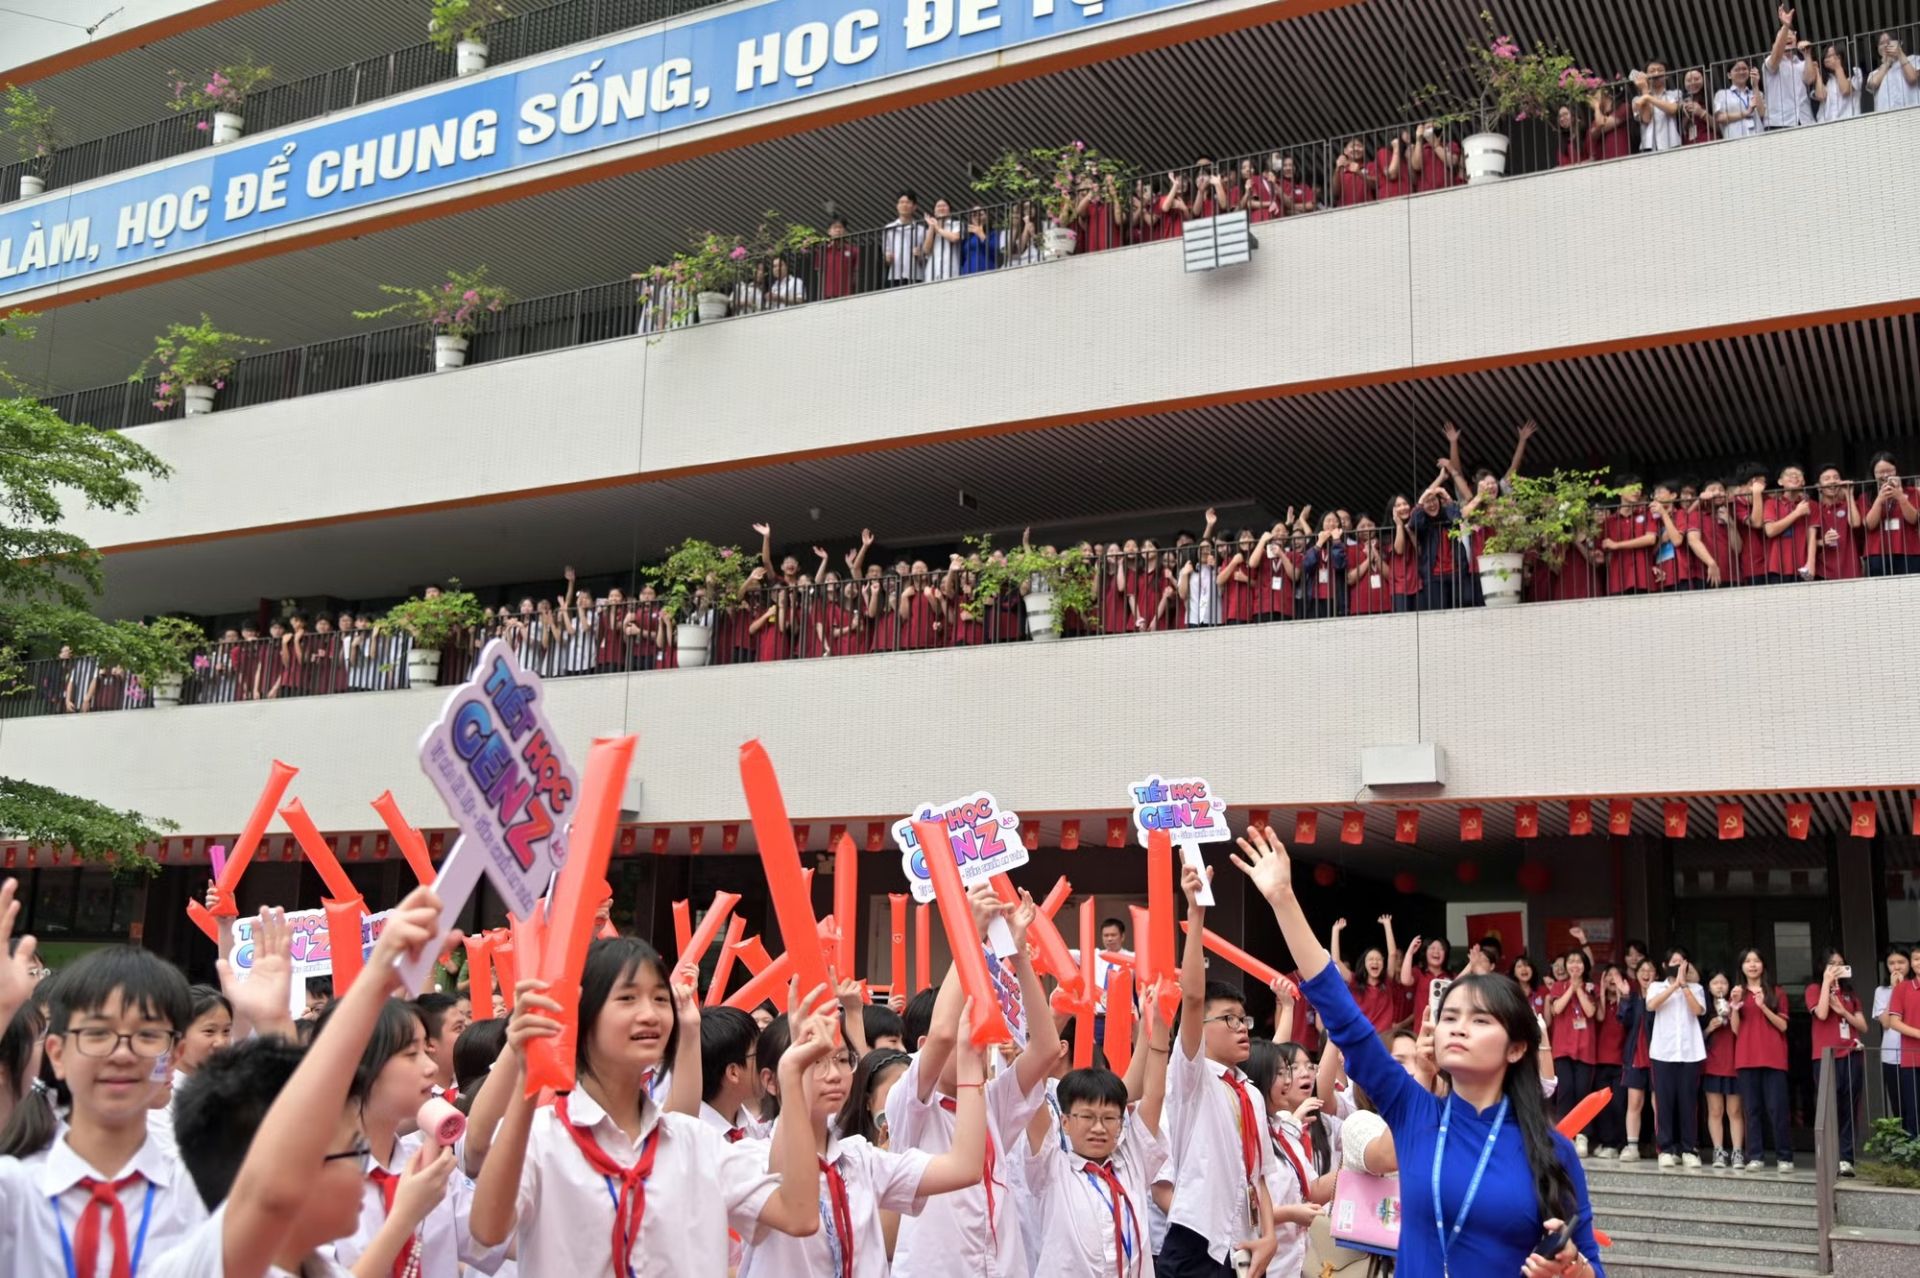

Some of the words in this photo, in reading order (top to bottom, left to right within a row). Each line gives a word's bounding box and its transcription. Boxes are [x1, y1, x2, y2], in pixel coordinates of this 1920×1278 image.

[0, 220, 99, 279] LÀM,
[116, 185, 210, 250] HỌC
[224, 141, 297, 221] ĐỂ
[306, 109, 498, 198] CHUNG
[517, 58, 710, 145] SỐNG,
[736, 8, 879, 92] HỌC
[484, 655, 538, 742] TIẾT
[521, 728, 573, 814] HỌC
[945, 798, 992, 832] HỌC
[1134, 779, 1168, 804] TIẾT
[1170, 782, 1206, 803] HỌC
